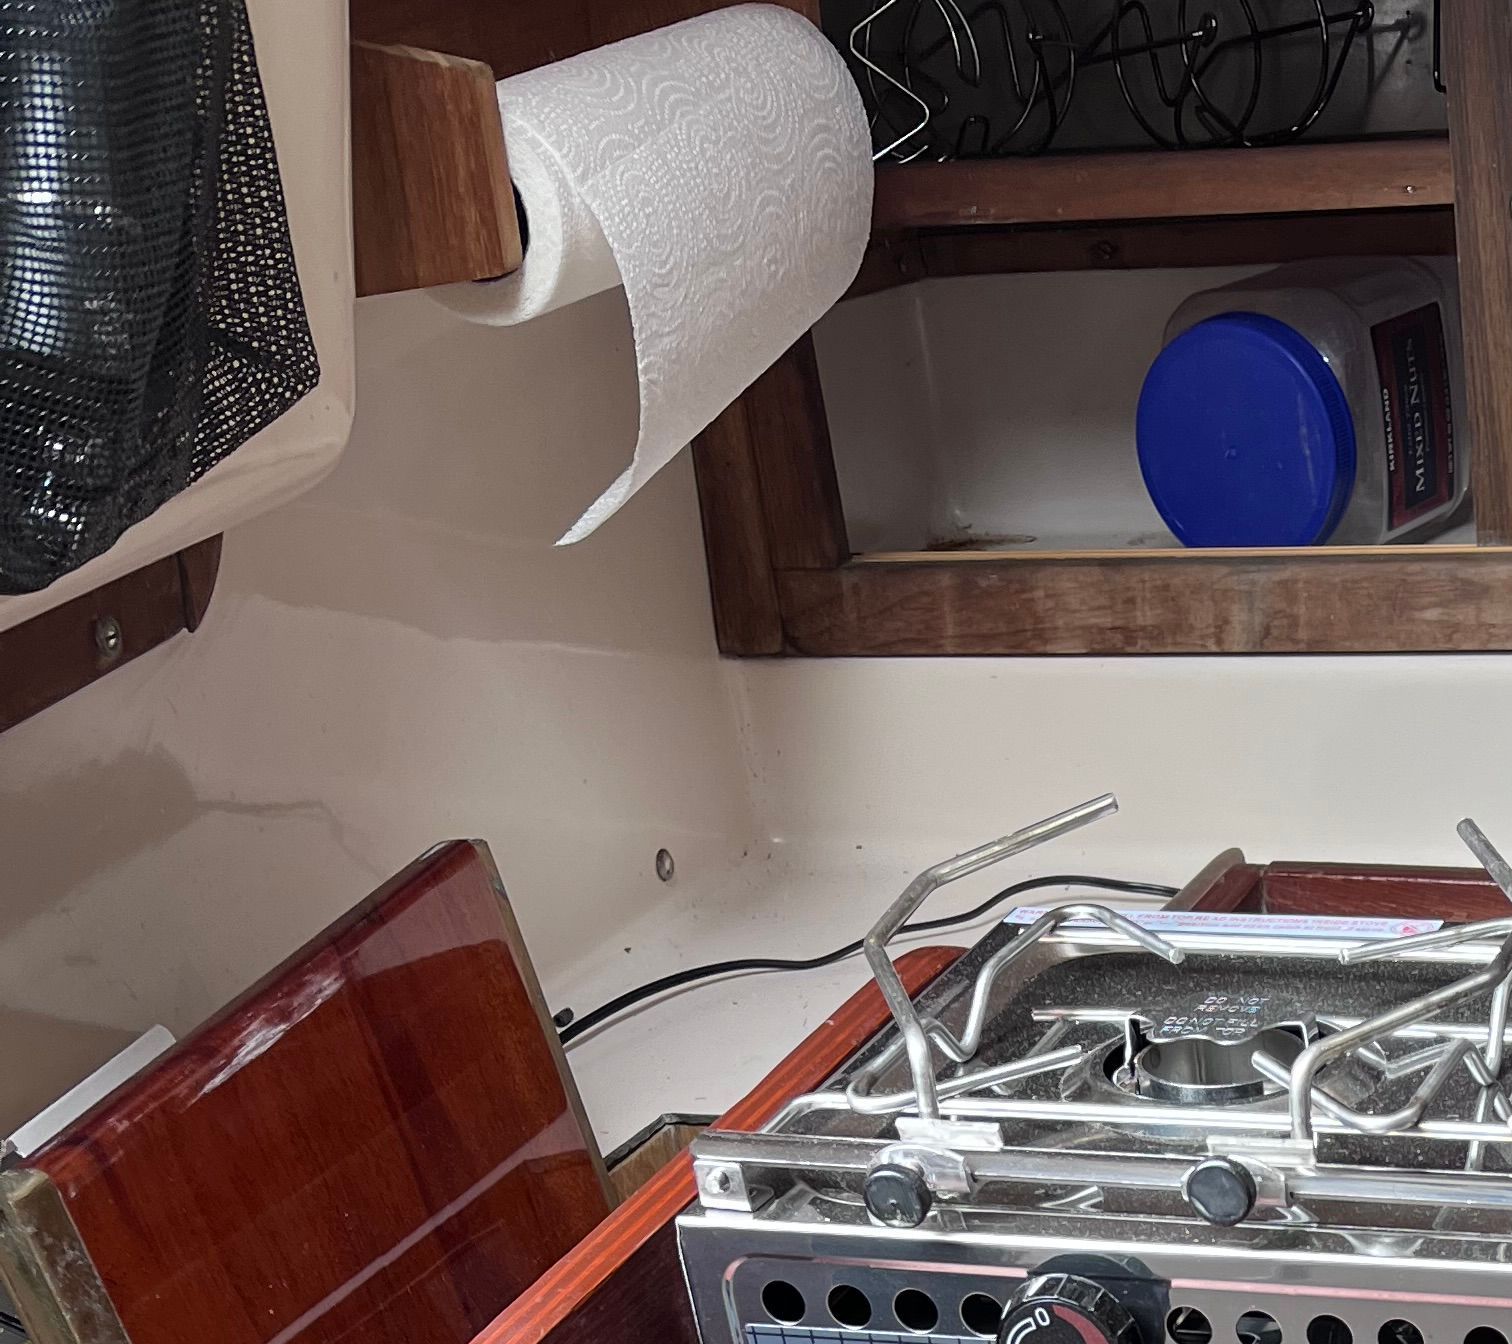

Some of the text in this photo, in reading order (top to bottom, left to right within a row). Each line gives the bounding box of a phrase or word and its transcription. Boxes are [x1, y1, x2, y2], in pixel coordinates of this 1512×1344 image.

[1382, 387, 1396, 472] KIRKLAND
[1413, 411, 1426, 494] MIXED
[1204, 996, 1271, 1005] DO NOT
[1194, 1004, 1261, 1014] REMOVE
[1164, 1016, 1189, 1025] DO
[1160, 1025, 1246, 1036] FROM TOP
